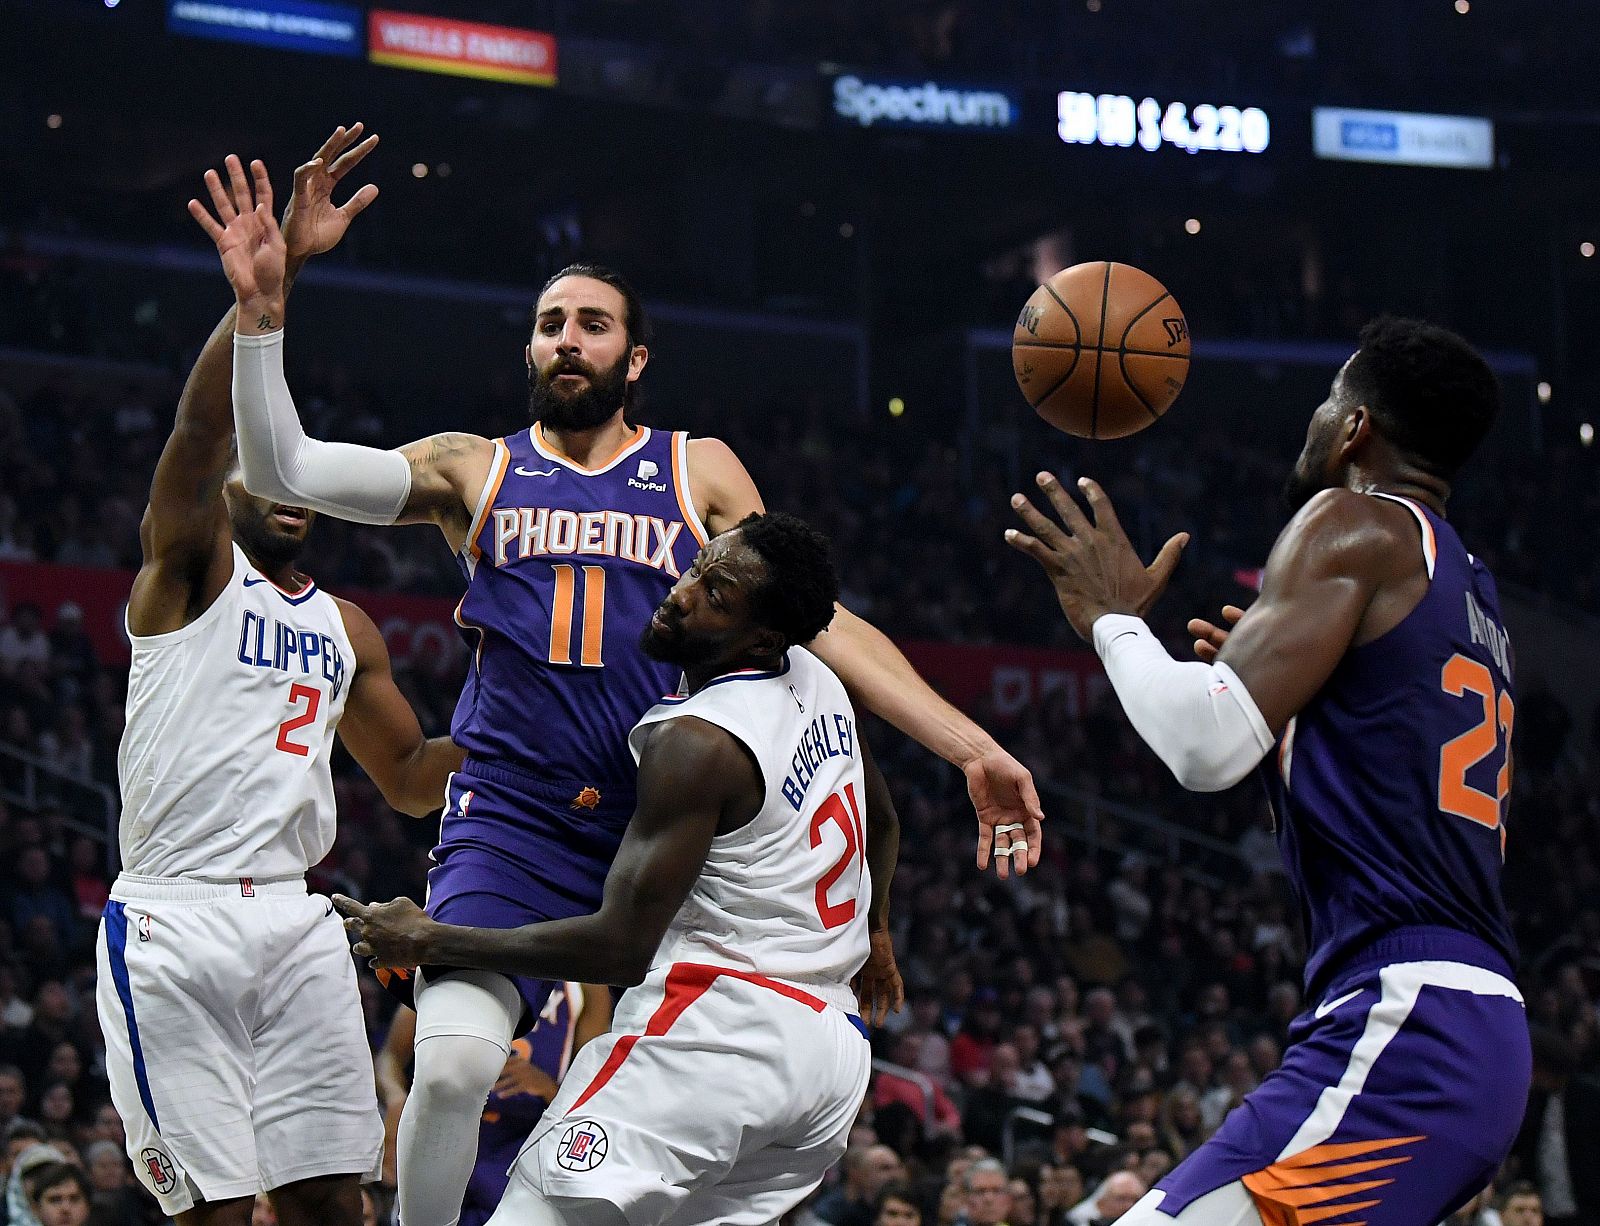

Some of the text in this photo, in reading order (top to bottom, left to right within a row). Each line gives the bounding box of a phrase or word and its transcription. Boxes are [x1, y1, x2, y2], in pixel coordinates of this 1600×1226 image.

[834, 75, 1010, 127] Spectrum
[627, 477, 667, 492] PayPal
[491, 507, 684, 580] PHOENIX
[548, 563, 606, 668] 11
[275, 682, 322, 757] 2
[781, 713, 854, 812] BEVERLEY
